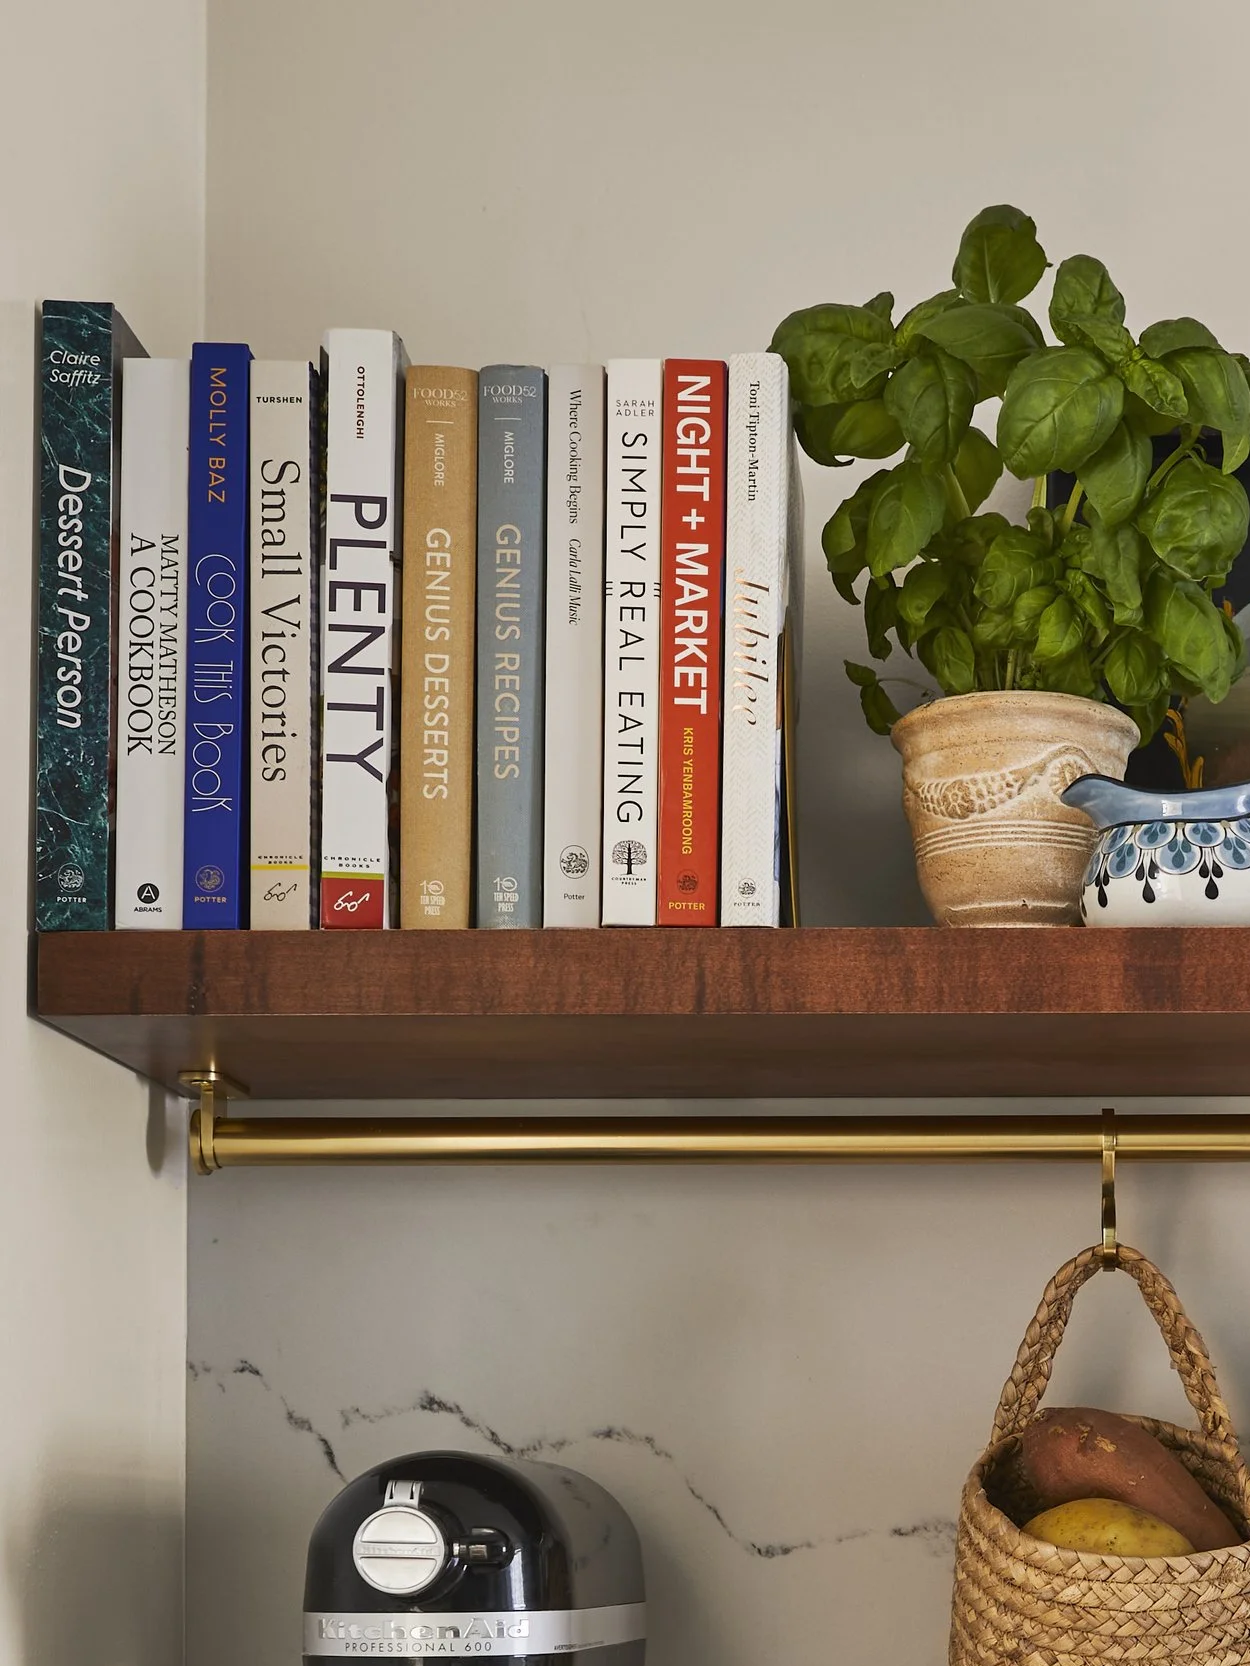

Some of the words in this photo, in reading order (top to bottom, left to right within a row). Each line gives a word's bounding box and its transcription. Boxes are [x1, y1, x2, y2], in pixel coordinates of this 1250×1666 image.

[50, 350, 101, 366] Claire
[50, 368, 101, 387] Saffitz
[209, 367, 228, 447] MOLLY
[356, 366, 365, 439] OTTOLENGHI
[413, 388, 468, 401] FOOD52
[425, 399, 457, 408] WORKS
[483, 385, 537, 397] FOOD52
[492, 396, 523, 404] WORKS
[568, 389, 582, 428] Where
[749, 380, 760, 408] Toni
[434, 433, 445, 487] MIGLORE
[504, 431, 514, 484] MIGLORE
[566, 432, 582, 482] Cooking
[676, 374, 711, 501] NIGHT
[746, 411, 760, 502] Tipton-Martin
[208, 457, 226, 503] BAZ
[566, 485, 581, 524] Begins
[621, 432, 648, 562] SIMPLY
[57, 463, 92, 602] Dessert
[261, 459, 302, 578] Small
[682, 508, 705, 530] +
[131, 533, 156, 556] A
[568, 538, 582, 568] Carla
[160, 534, 179, 618] MATTY
[194, 553, 236, 644] COOK
[425, 528, 452, 642] GENIUS
[495, 524, 522, 640] GENIUS
[568, 570, 581, 594] Lalli
[568, 596, 581, 626] Music
[619, 581, 646, 672] REAL
[673, 541, 709, 715] MARKET
[128, 567, 155, 756] COOKBOOK
[326, 494, 387, 783] PLENTY
[733, 565, 770, 727] Jubilee
[55, 608, 91, 730] Person
[158, 622, 177, 756] MATHESON
[261, 593, 302, 783] Victories
[423, 654, 449, 800] DESSERTS
[494, 653, 520, 780] RECIPES
[683, 727, 693, 756] KRIS
[191, 722, 234, 812] BOOK
[616, 692, 645, 824] EATING
[681, 759, 693, 855] YENBAMROONG
[56, 896, 87, 904] POTTER
[194, 896, 227, 904] POTTER
[420, 896, 429, 905] TEN
[430, 896, 446, 906] SPEED
[424, 906, 440, 916] PRESS
[493, 893, 502, 902] TEN
[503, 893, 519, 902] SPEED
[498, 902, 514, 912] PRESS
[668, 902, 705, 911] POTTER
[317, 1617, 531, 1640] KitchenAid
[345, 1642, 455, 1652] PROFESSIONAL
[464, 1641, 492, 1652] 600
